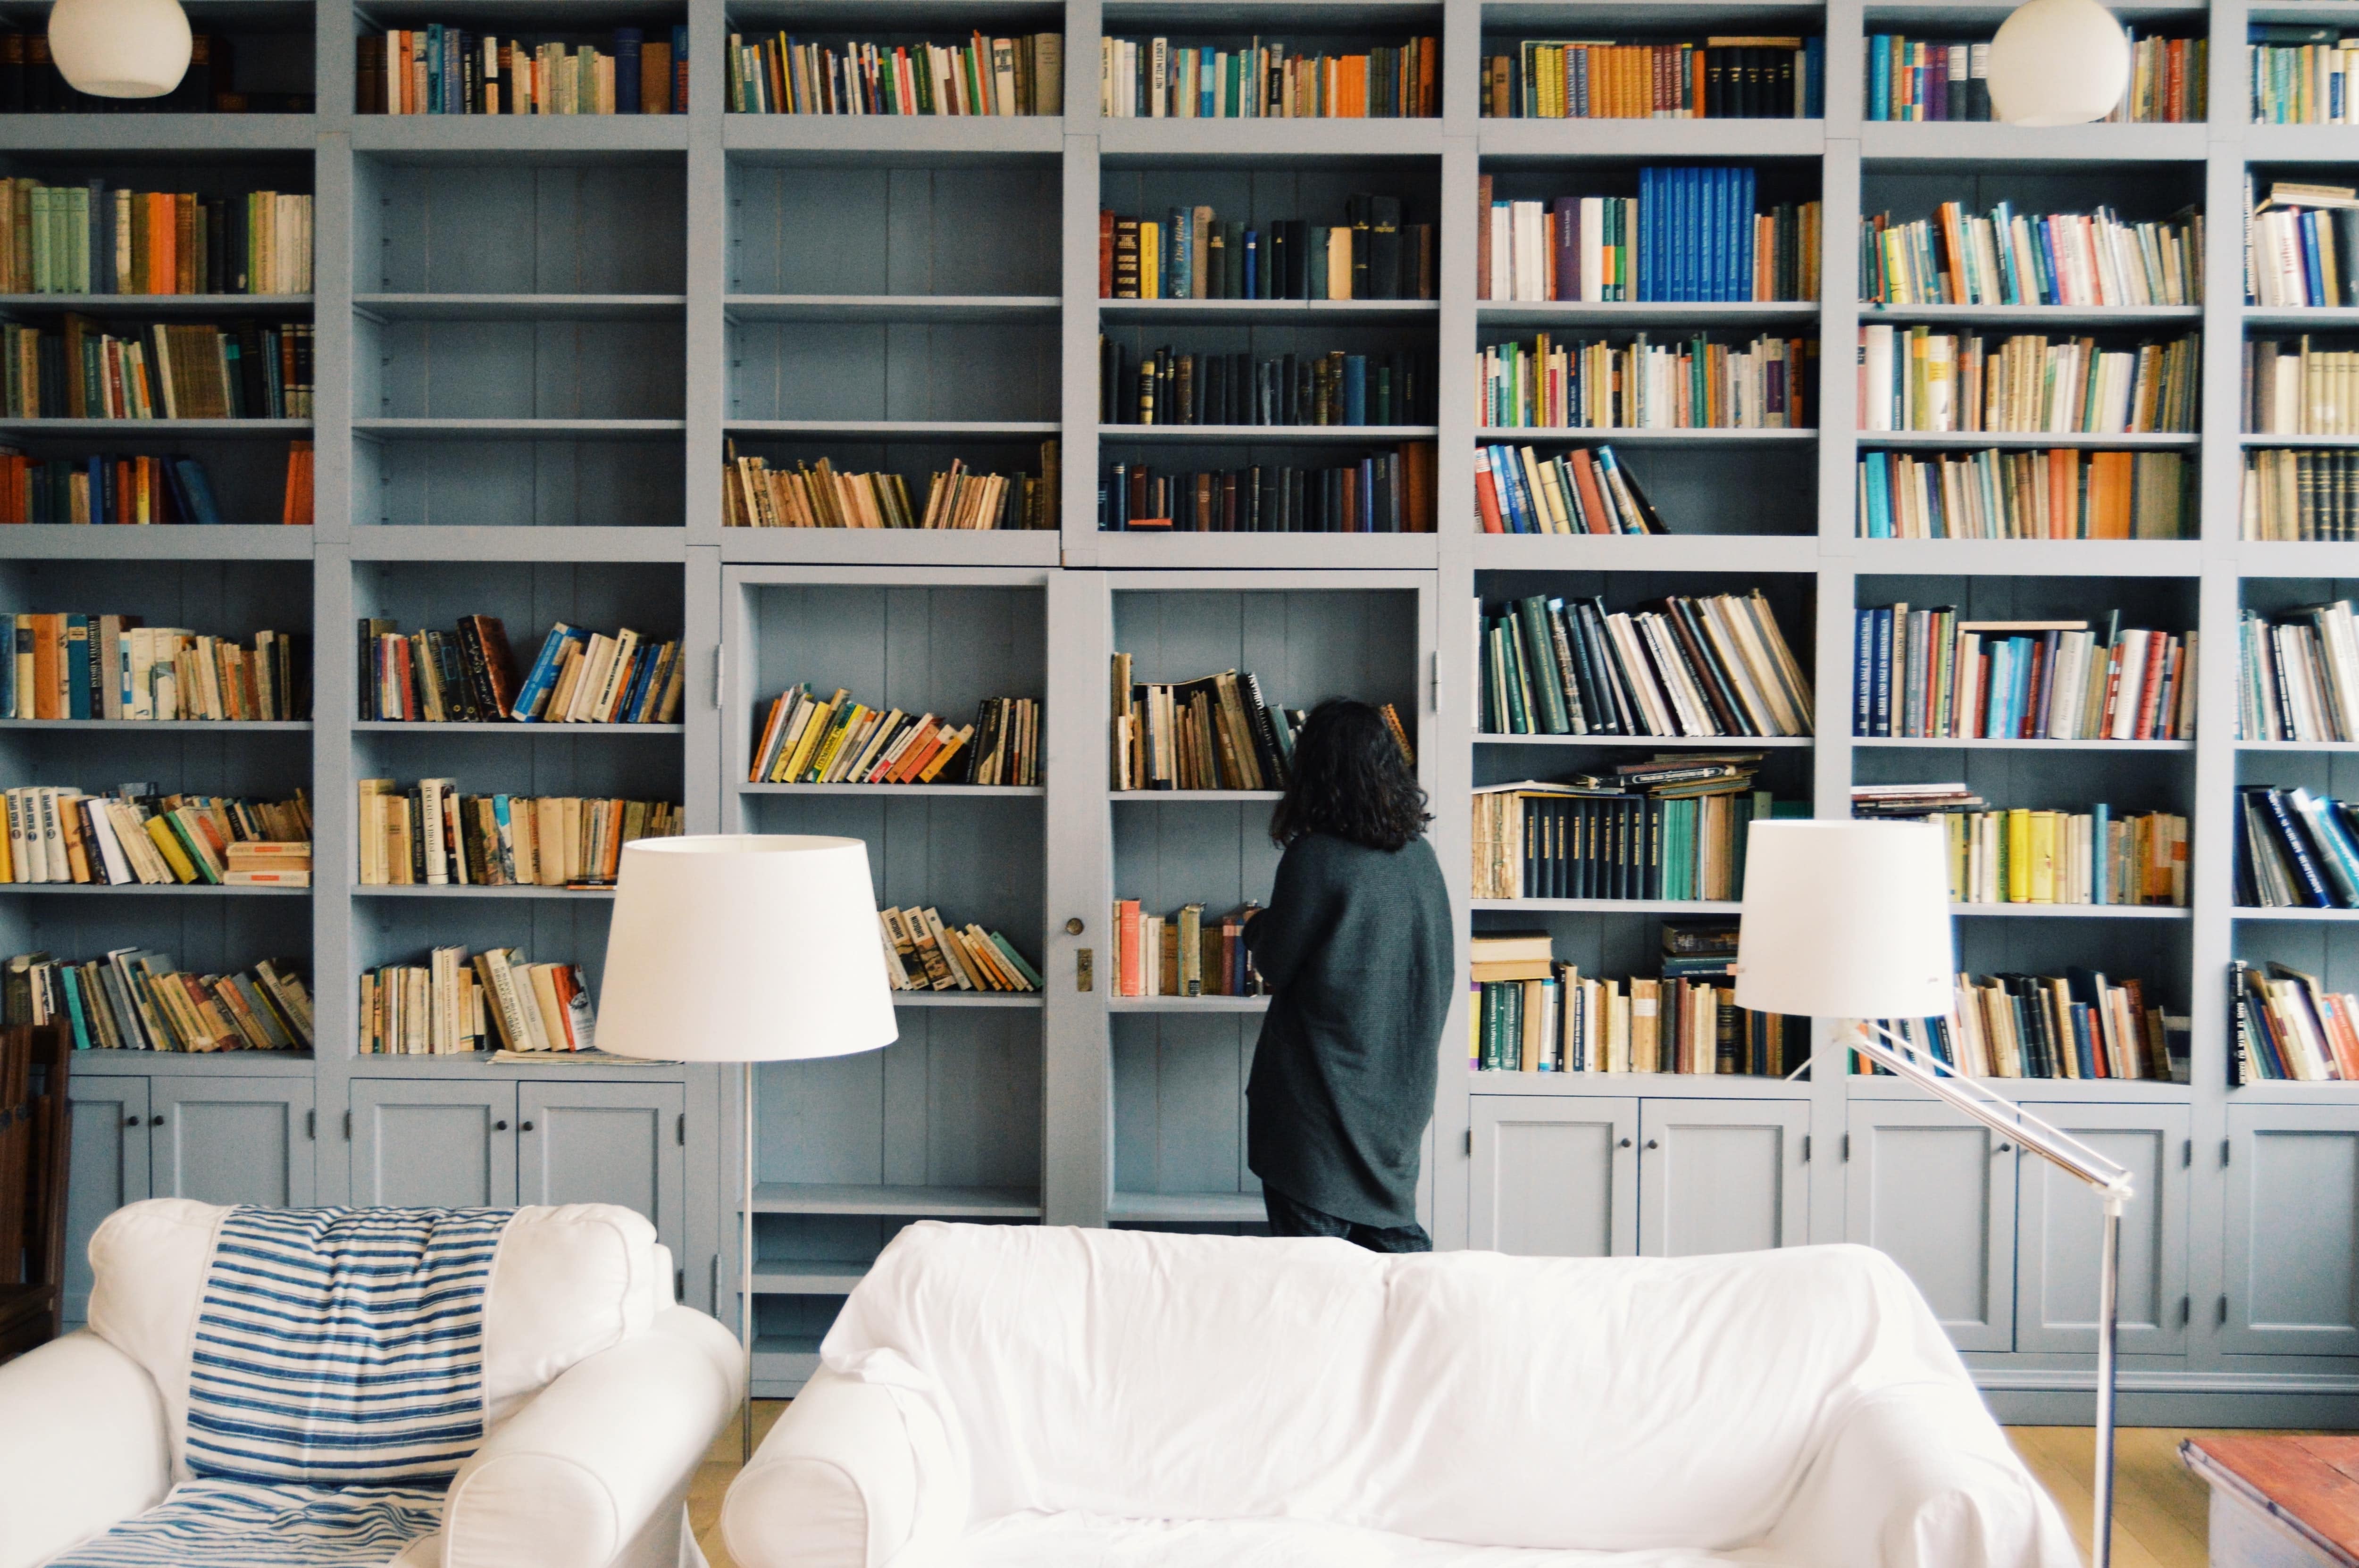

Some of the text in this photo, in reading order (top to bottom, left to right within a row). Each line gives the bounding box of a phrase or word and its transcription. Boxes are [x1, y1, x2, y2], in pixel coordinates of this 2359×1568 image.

[1175, 216, 1184, 242] Bibel
[89, 621, 97, 658] FILOZOFIEI
[1860, 617, 1870, 658] SIEBENBÜRGEN
[1878, 619, 1888, 659] SIEBENBÜRGEN
[1861, 668, 1869, 680] SALZ
[1879, 669, 1887, 682] SALZ
[1860, 682, 1868, 693] UND
[1878, 684, 1887, 695] UND
[1859, 696, 1868, 714] SILBER
[1878, 697, 1886, 715] SILBER
[8, 795, 19, 827] BLAGA OPERE
[25, 797, 35, 829] BLAGA OPERE
[42, 795, 53, 827] BLAGA OPERE
[888, 916, 904, 939] SHOGUN
[910, 915, 925, 938] SHOGUN
[506, 1015, 519, 1041] ISTORIA
[2238, 1050, 2245, 1059] DU
